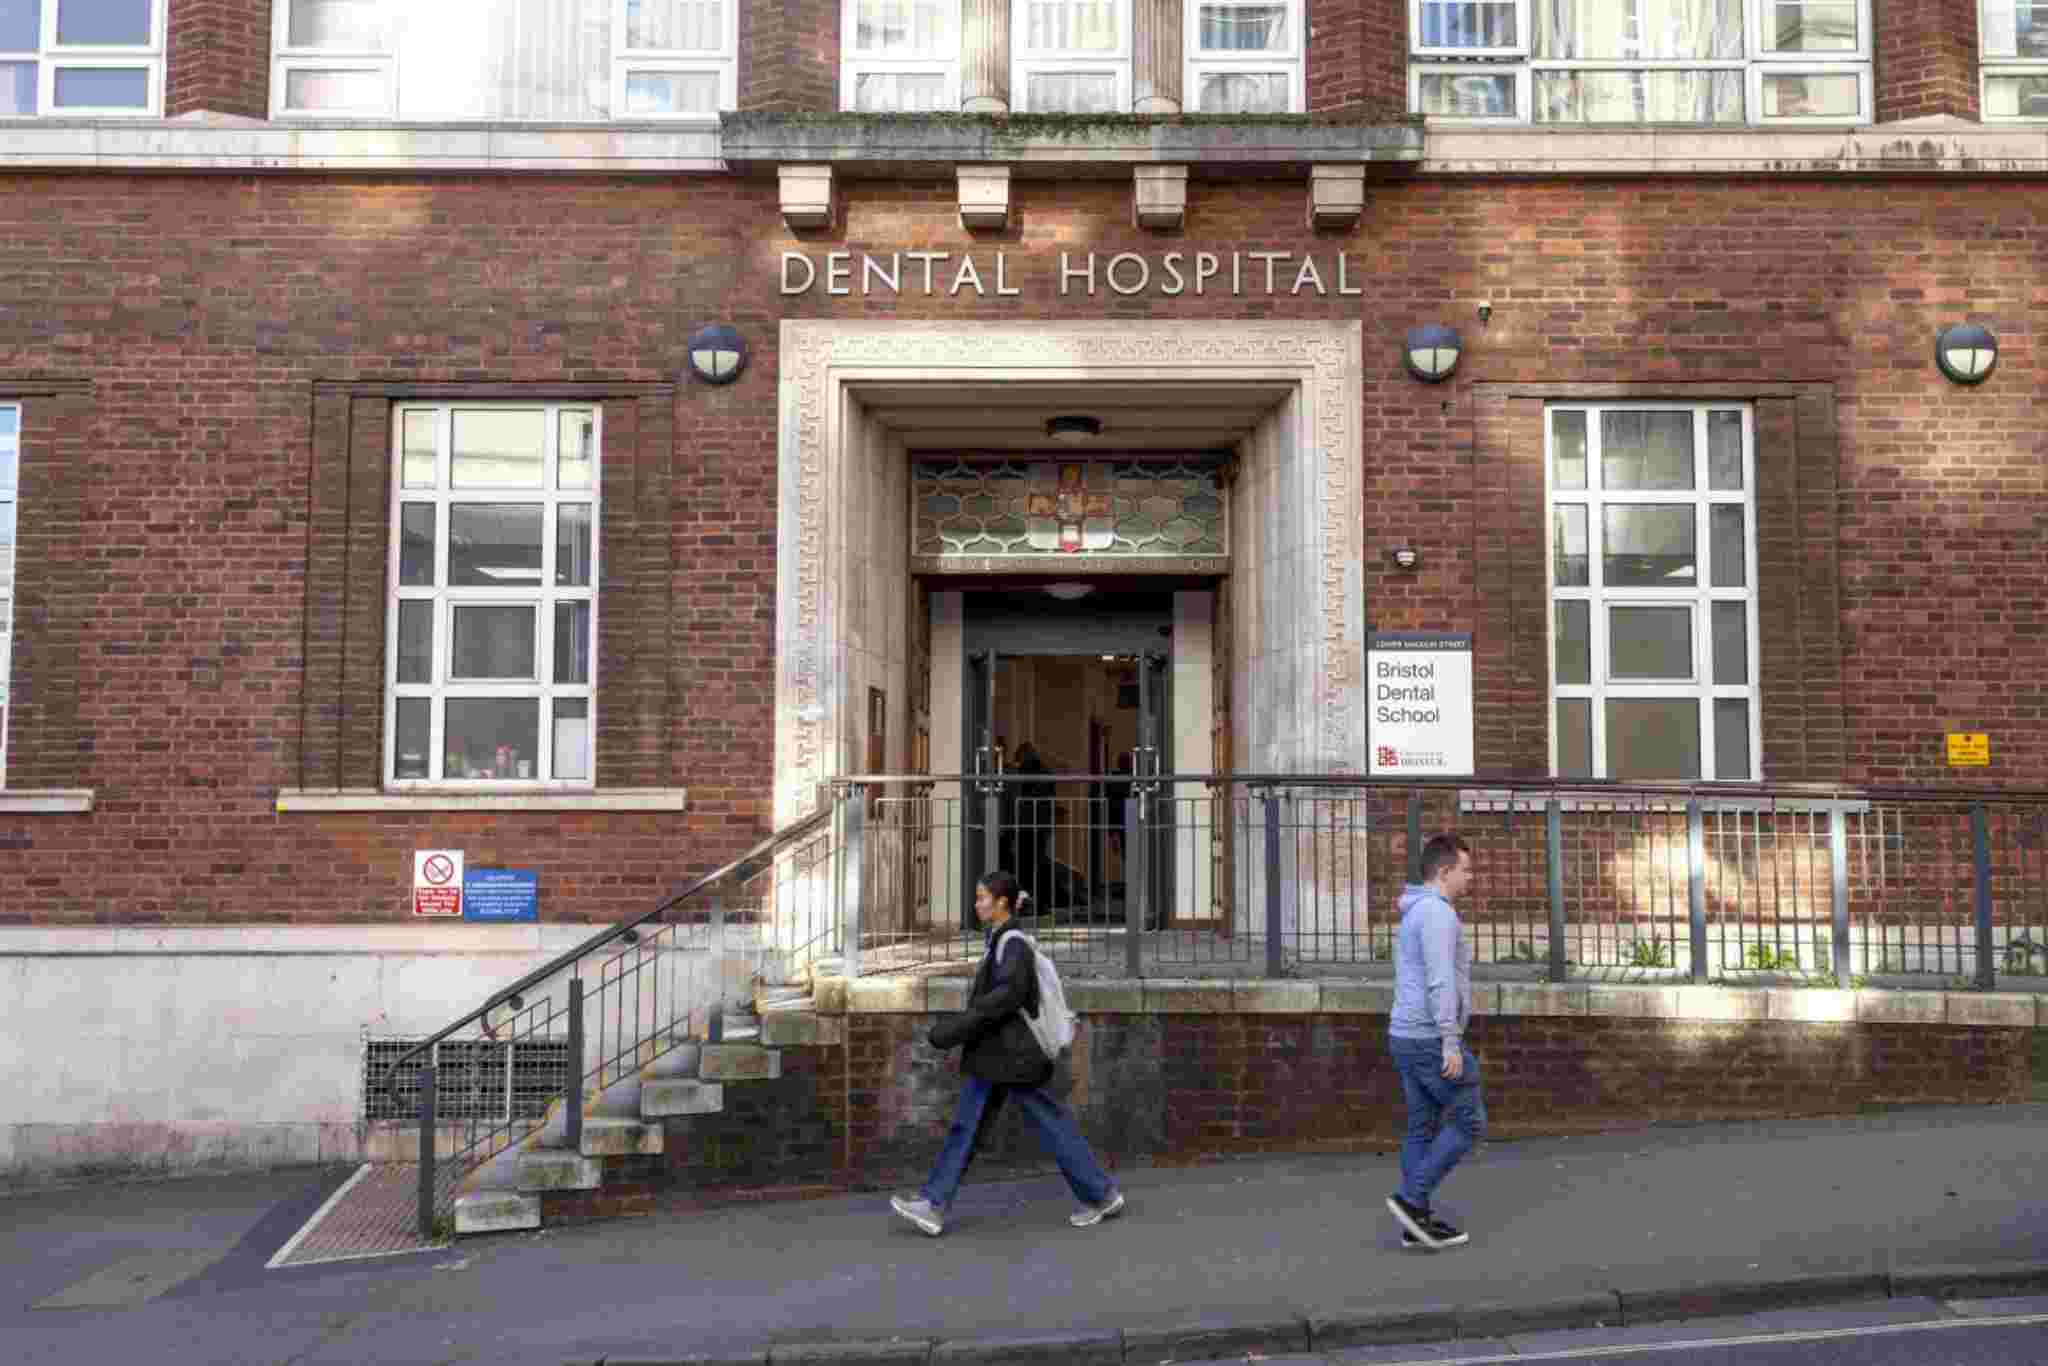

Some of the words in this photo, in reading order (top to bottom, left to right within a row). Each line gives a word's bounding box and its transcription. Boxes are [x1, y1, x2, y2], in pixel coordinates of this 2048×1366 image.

[779, 251, 1019, 296] DENTAL
[1060, 251, 1363, 295] HOSPITAL
[1376, 661, 1434, 679] Bristol
[1376, 684, 1435, 701] Dental
[1376, 706, 1440, 723] School
